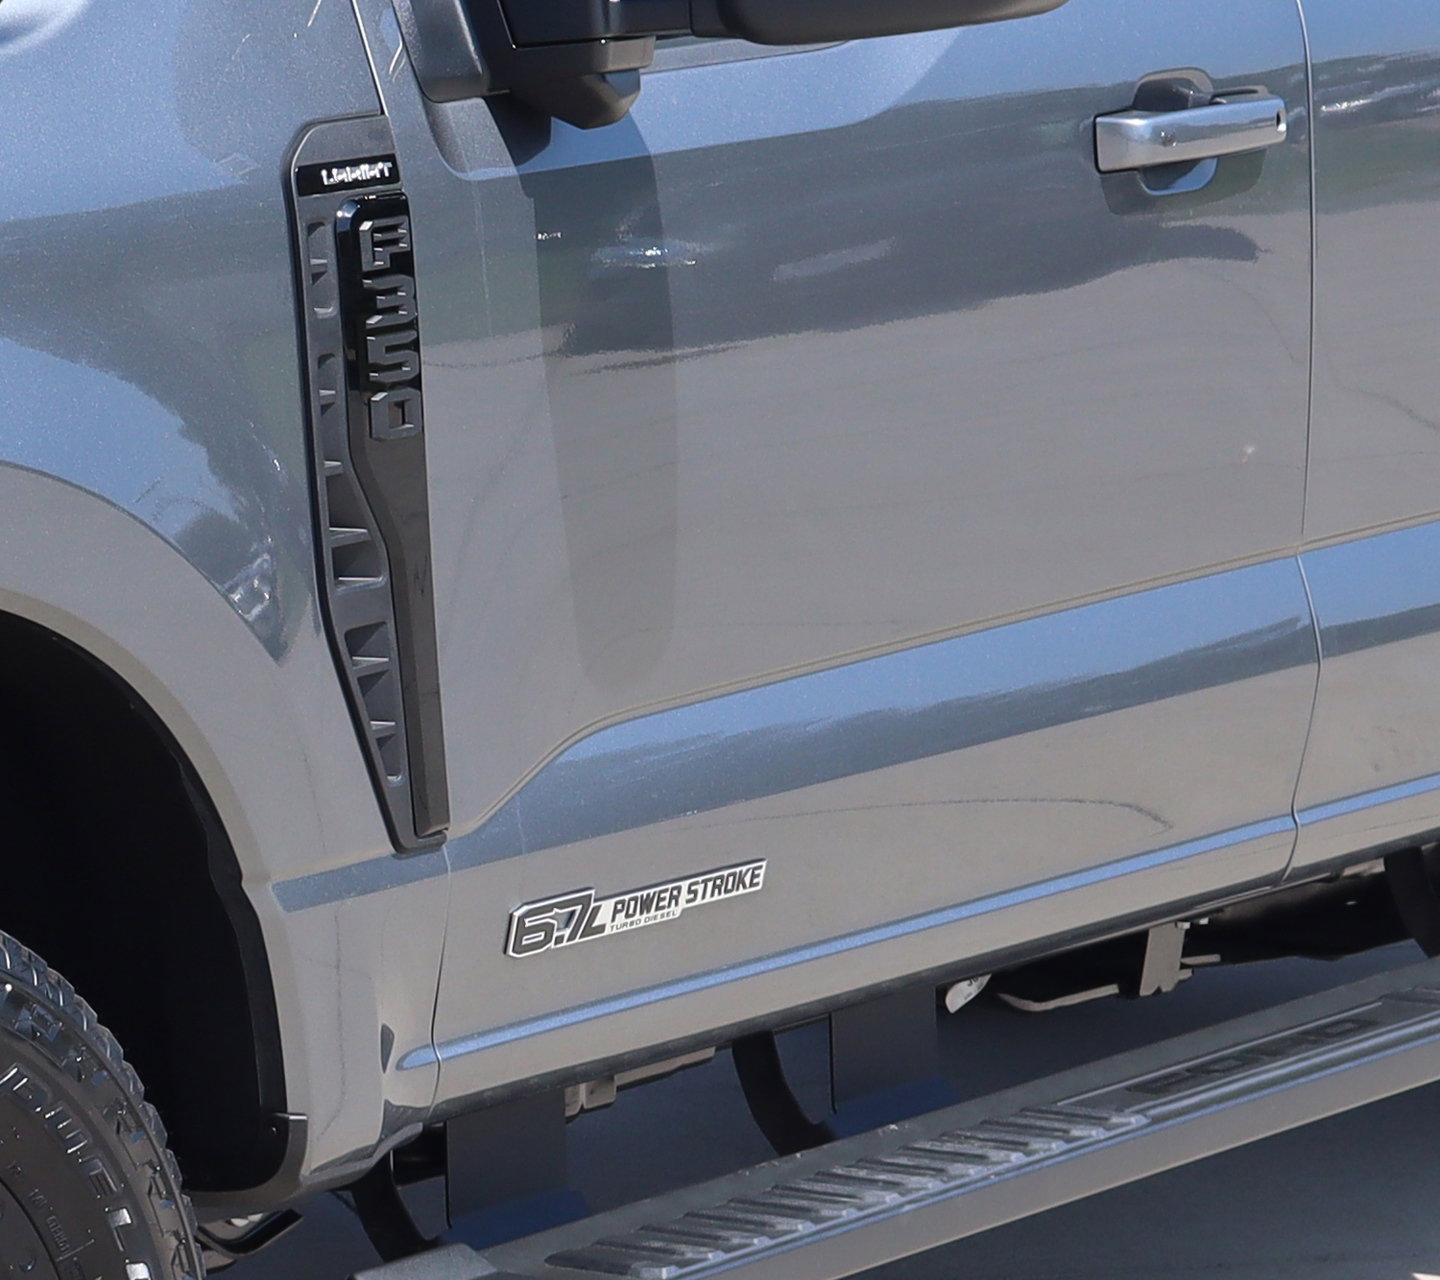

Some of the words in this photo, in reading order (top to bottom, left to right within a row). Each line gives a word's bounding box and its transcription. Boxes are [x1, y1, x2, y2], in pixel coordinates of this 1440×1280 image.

[360, 216, 423, 440] F350
[512, 891, 608, 956] 6.7L
[611, 884, 682, 923] POWER
[685, 865, 764, 905] STROKE
[610, 917, 641, 932] TURBO
[644, 909, 678, 924] DIESEL
